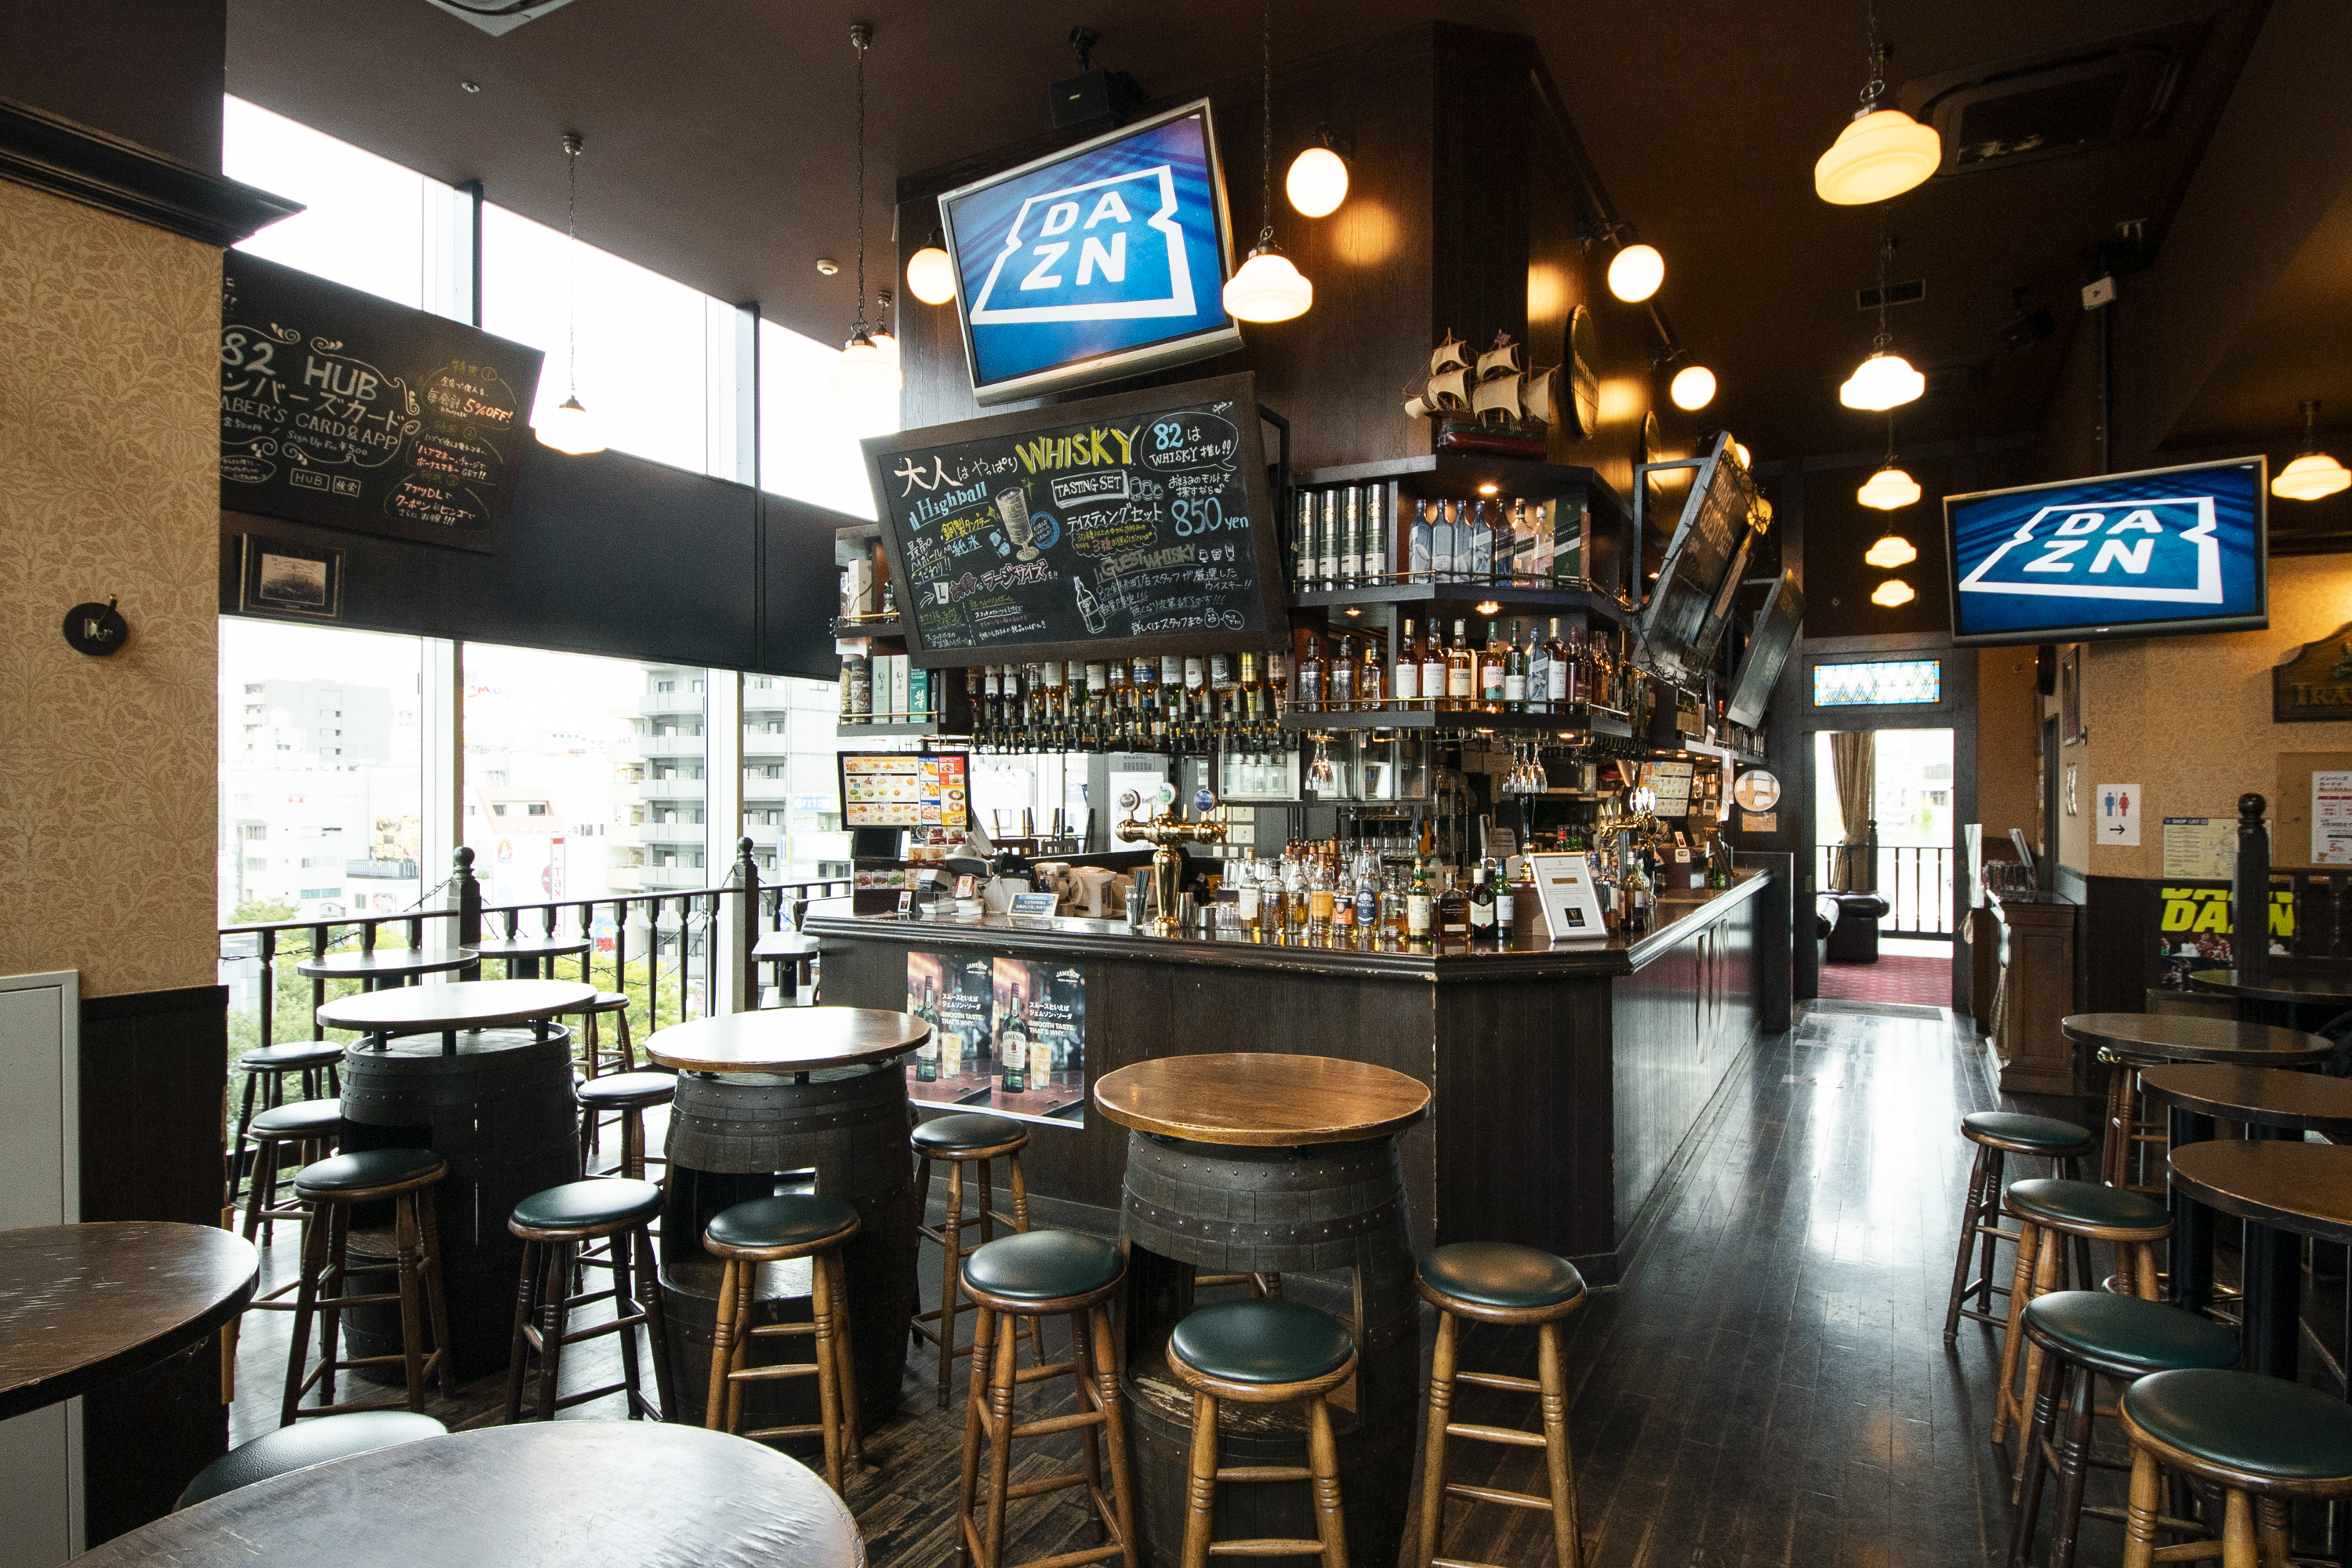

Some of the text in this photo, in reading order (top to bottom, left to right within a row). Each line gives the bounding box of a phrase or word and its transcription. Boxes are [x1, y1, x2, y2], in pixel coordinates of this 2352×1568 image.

[221, 332, 379, 401] 82 HUB
[463, 397, 514, 424] 5%OFF!
[1015, 425, 1142, 474] WHISKY
[1149, 447, 1197, 466] WHISKY
[295, 472, 323, 486] HUB
[335, 479, 358, 493] 検索
[1055, 475, 1121, 499] TASTING SET
[916, 481, 988, 521] Highball
[1171, 496, 1249, 537] 850 yen
[1102, 543, 1196, 576] GUEST WHISKY
[2161, 899, 2296, 937] DAN
[1056, 970, 1081, 979] JAMESON
[942, 993, 978, 1003] スムースといえば
[942, 1000, 981, 1011] ジェムソン・ソーダ
[1029, 1002, 1070, 1011] スムースといえば
[1029, 1009, 1073, 1020] ジェムソン・ソーダ
[1029, 1020, 1054, 1029] SMOOTH
[1004, 1033, 1025, 1044] JAMESON
